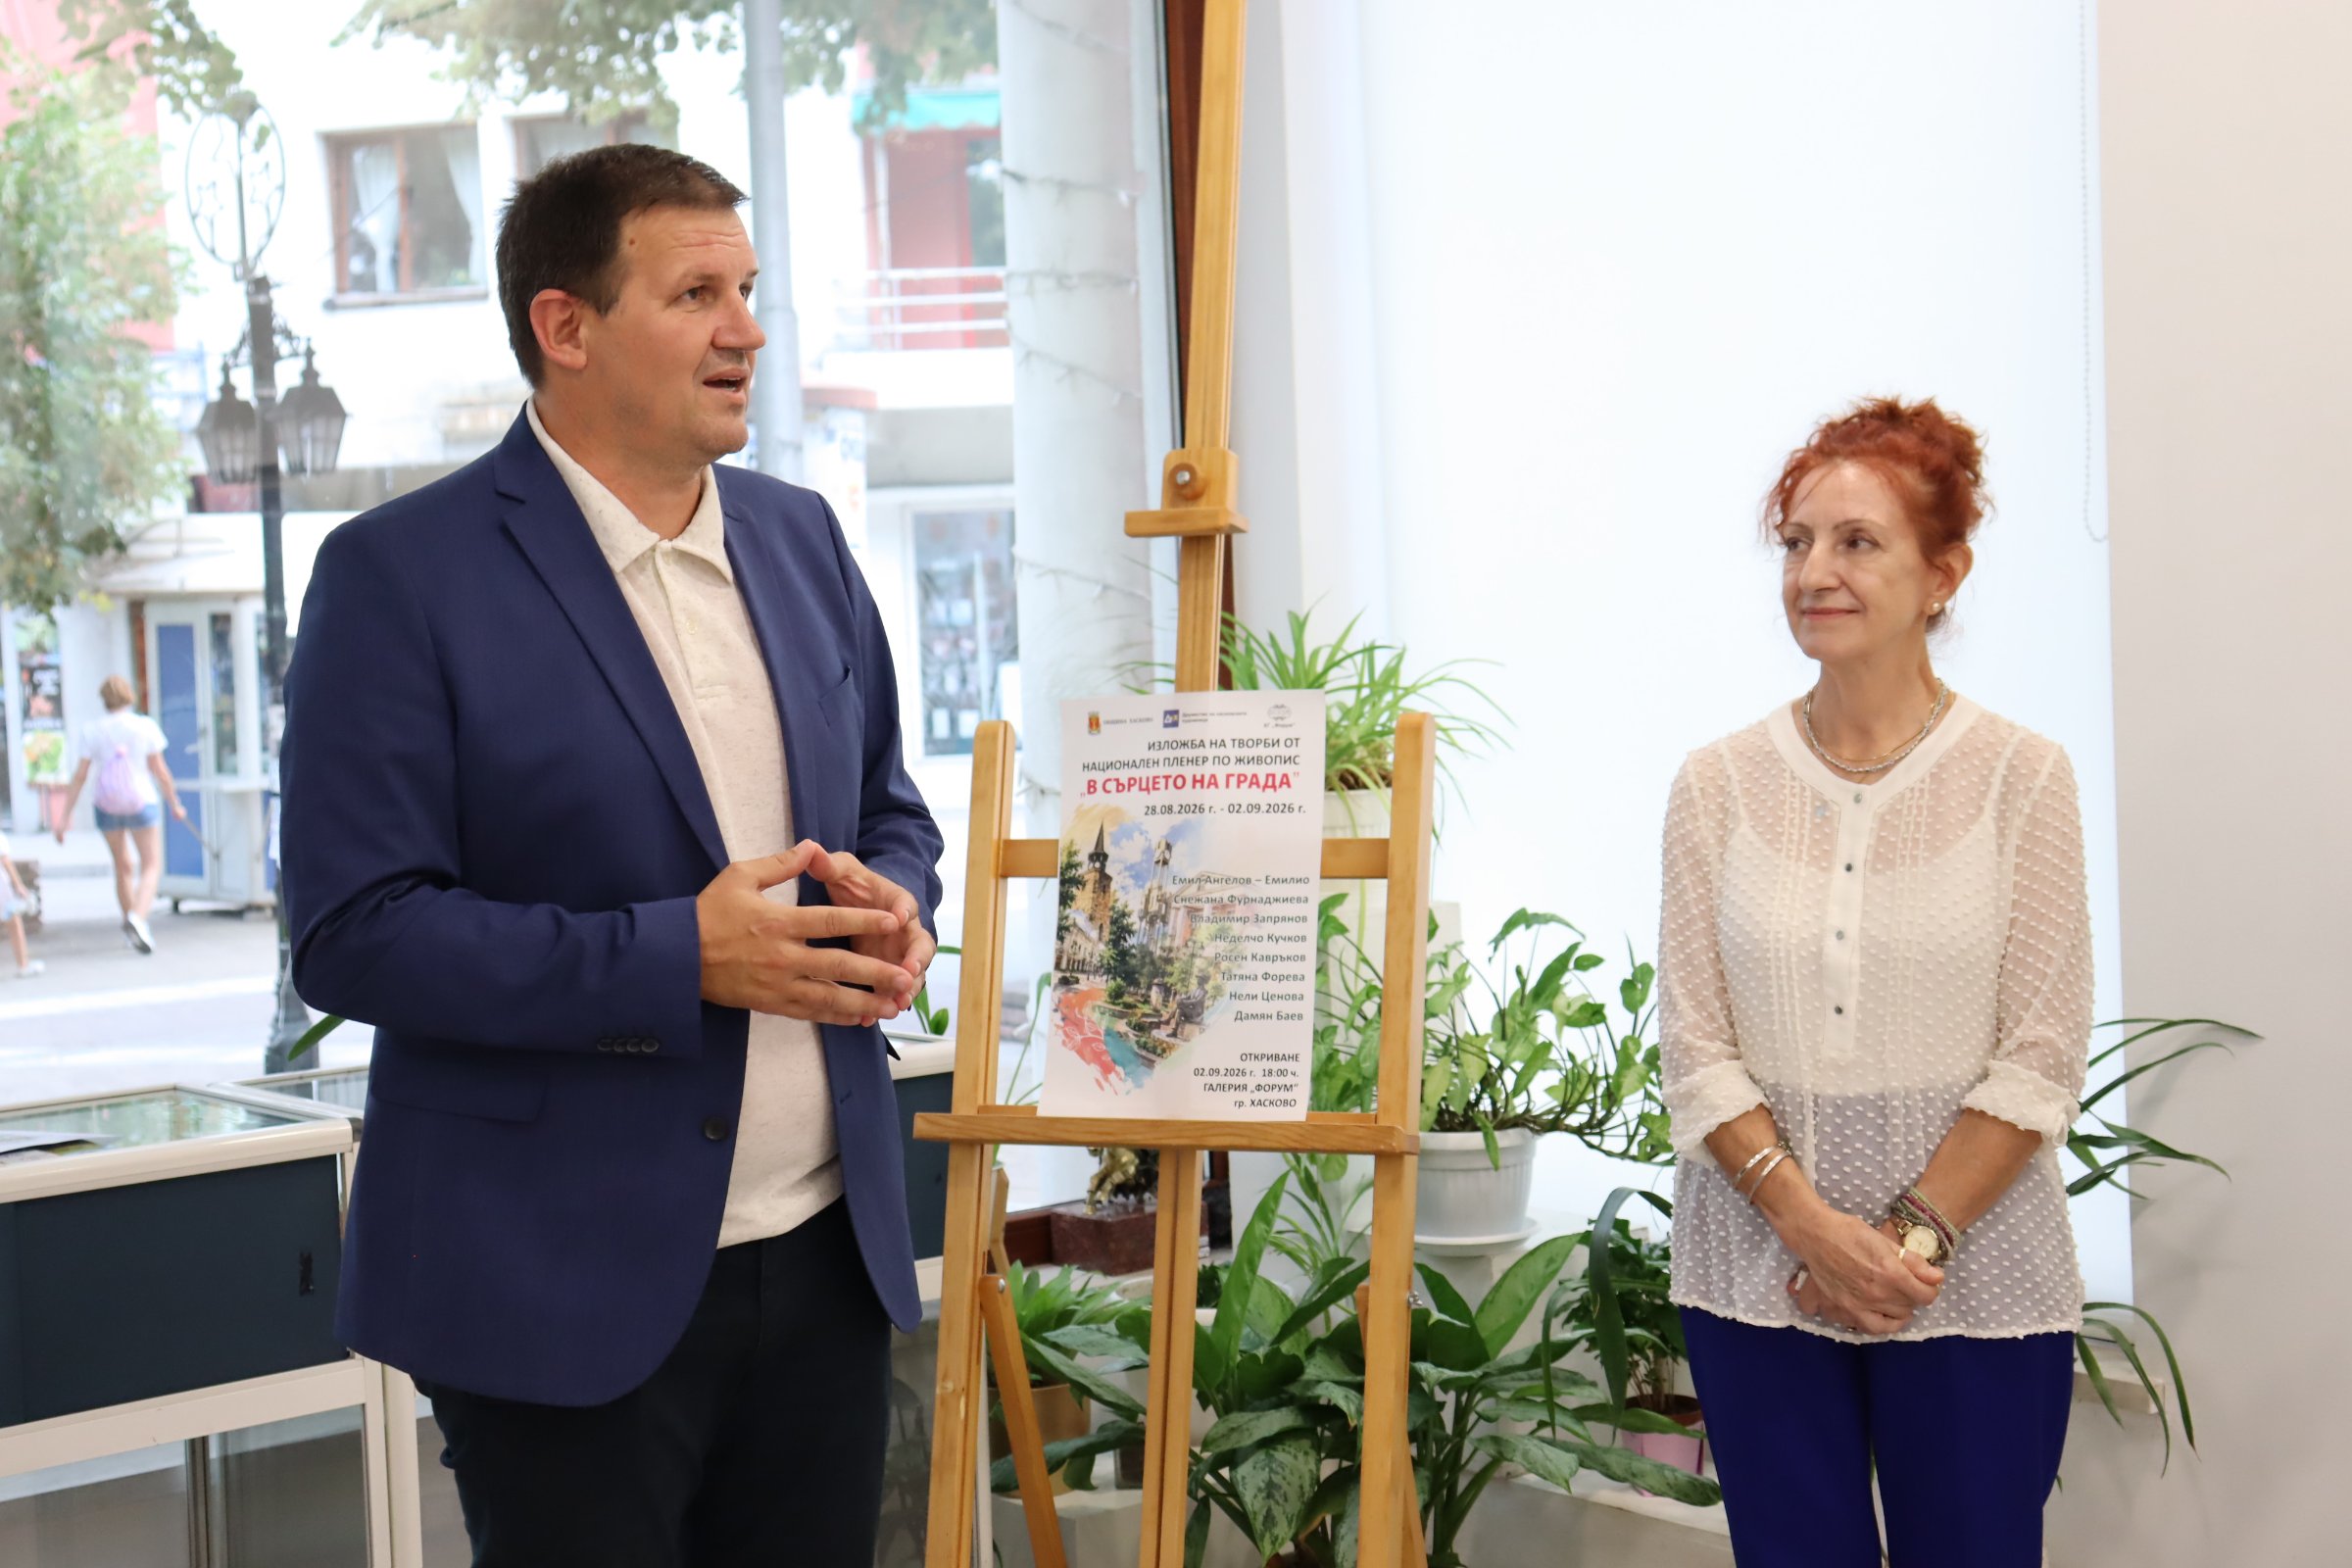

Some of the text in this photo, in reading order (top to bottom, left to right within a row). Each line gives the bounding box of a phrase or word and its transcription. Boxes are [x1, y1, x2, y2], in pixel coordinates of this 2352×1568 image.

[1148, 737, 1300, 752] ИЗЛОЖБА НА ТВОРБИ ОТ
[1082, 755, 1300, 772] НАЦИОНАЛЕН ПЛЕНЕР ПО ЖИВОПИС
[1102, 774, 1187, 795] СЪРЦЕТО
[1192, 773, 1219, 790] НА
[1144, 804, 1205, 815] 28.08.2026
[1208, 806, 1216, 814] г.
[1228, 803, 1295, 814] 02.09.2026
[1298, 805, 1306, 813] г.
[1205, 875, 1252, 886] Ангелов
[1265, 874, 1310, 885] Емилио
[1174, 894, 1309, 906] Снежана Фурнаджиева
[1190, 913, 1308, 925] Владимир Запрянов
[1214, 933, 1307, 945] Неделчо Кучков
[1214, 953, 1306, 964] Росен Кавръков
[1221, 971, 1305, 983] Татяна Форева
[1229, 991, 1304, 1003] Нели Ценова
[1234, 1010, 1303, 1022] Дамян Баев
[1240, 1053, 1300, 1062] ОТКРИВАНЕ
[1193, 1067, 1247, 1077] 02.09.2026
[1262, 1068, 1289, 1077] 18:00
[1203, 1083, 1248, 1093] ГАЛЕРИЯ
[1234, 1099, 1297, 1109] гр. ХАСКОВО
